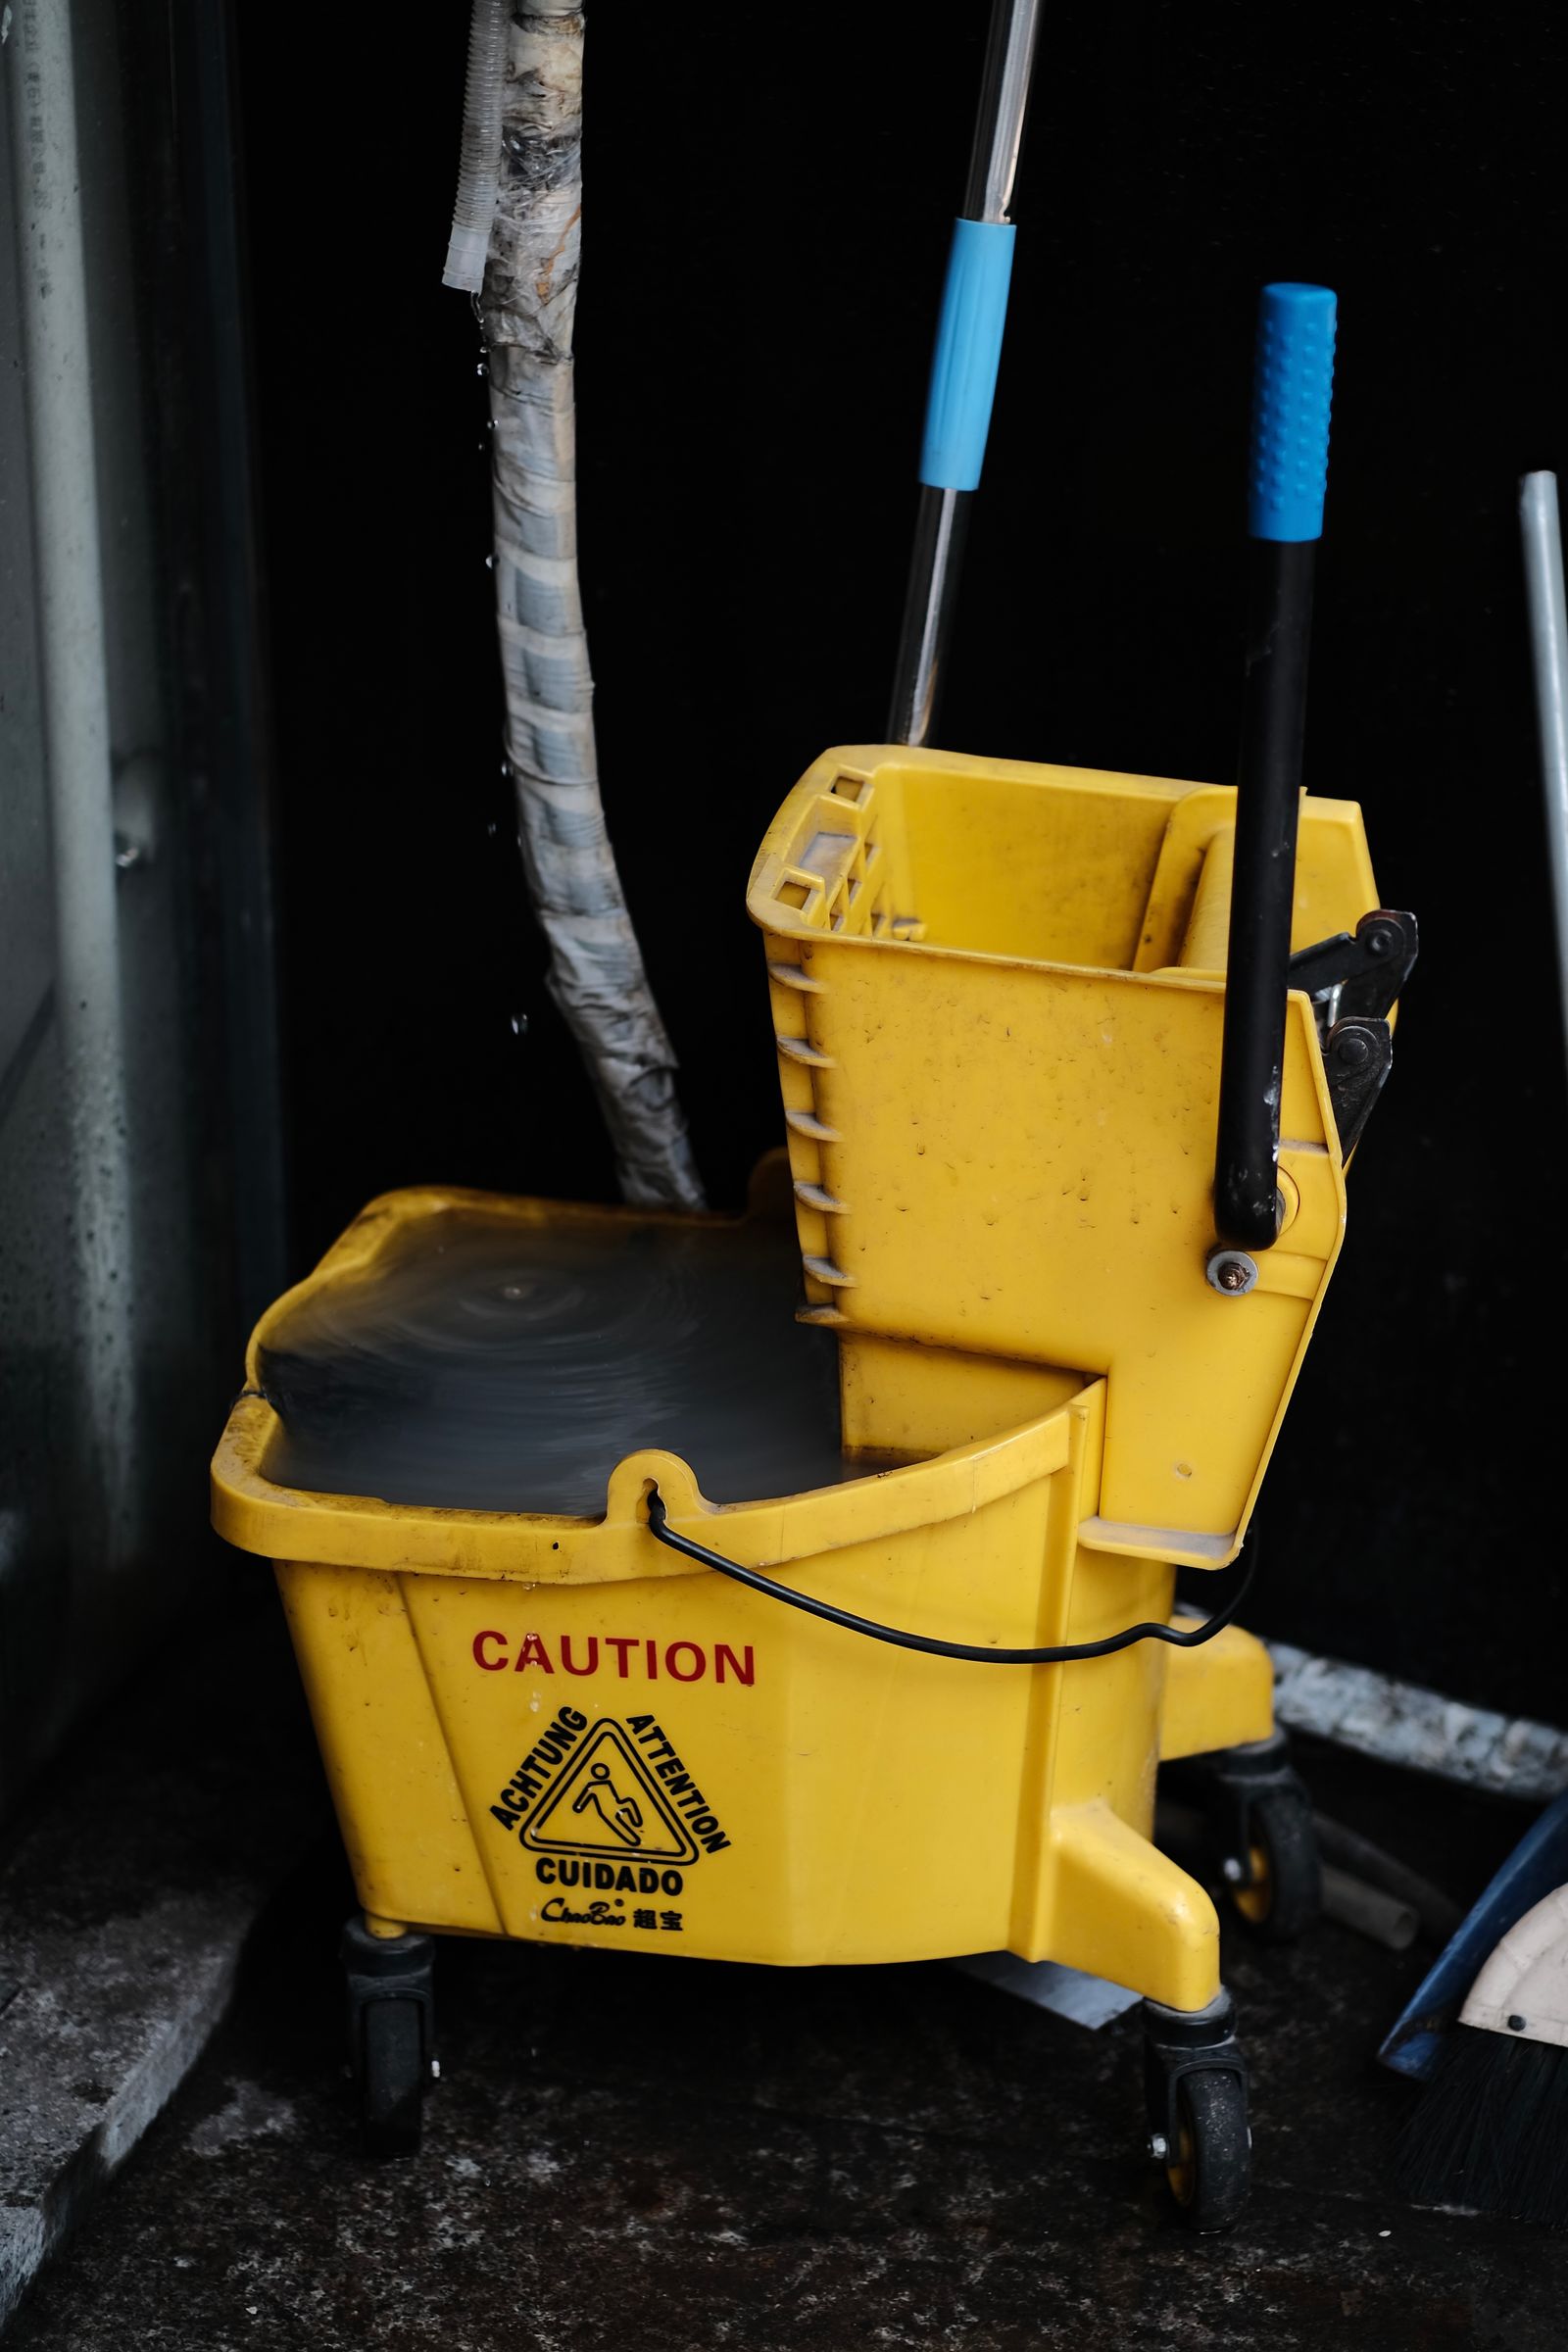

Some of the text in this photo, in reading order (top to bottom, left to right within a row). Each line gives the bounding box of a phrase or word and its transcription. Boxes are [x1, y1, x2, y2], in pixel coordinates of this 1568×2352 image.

[472, 1630, 755, 1687] CAUTION
[489, 1706, 588, 1831] ACHTUNG
[625, 1714, 731, 1854] ATTENTION
[535, 1858, 683, 1896] CUIDADO
[633, 1909, 683, 1932] 超宝
